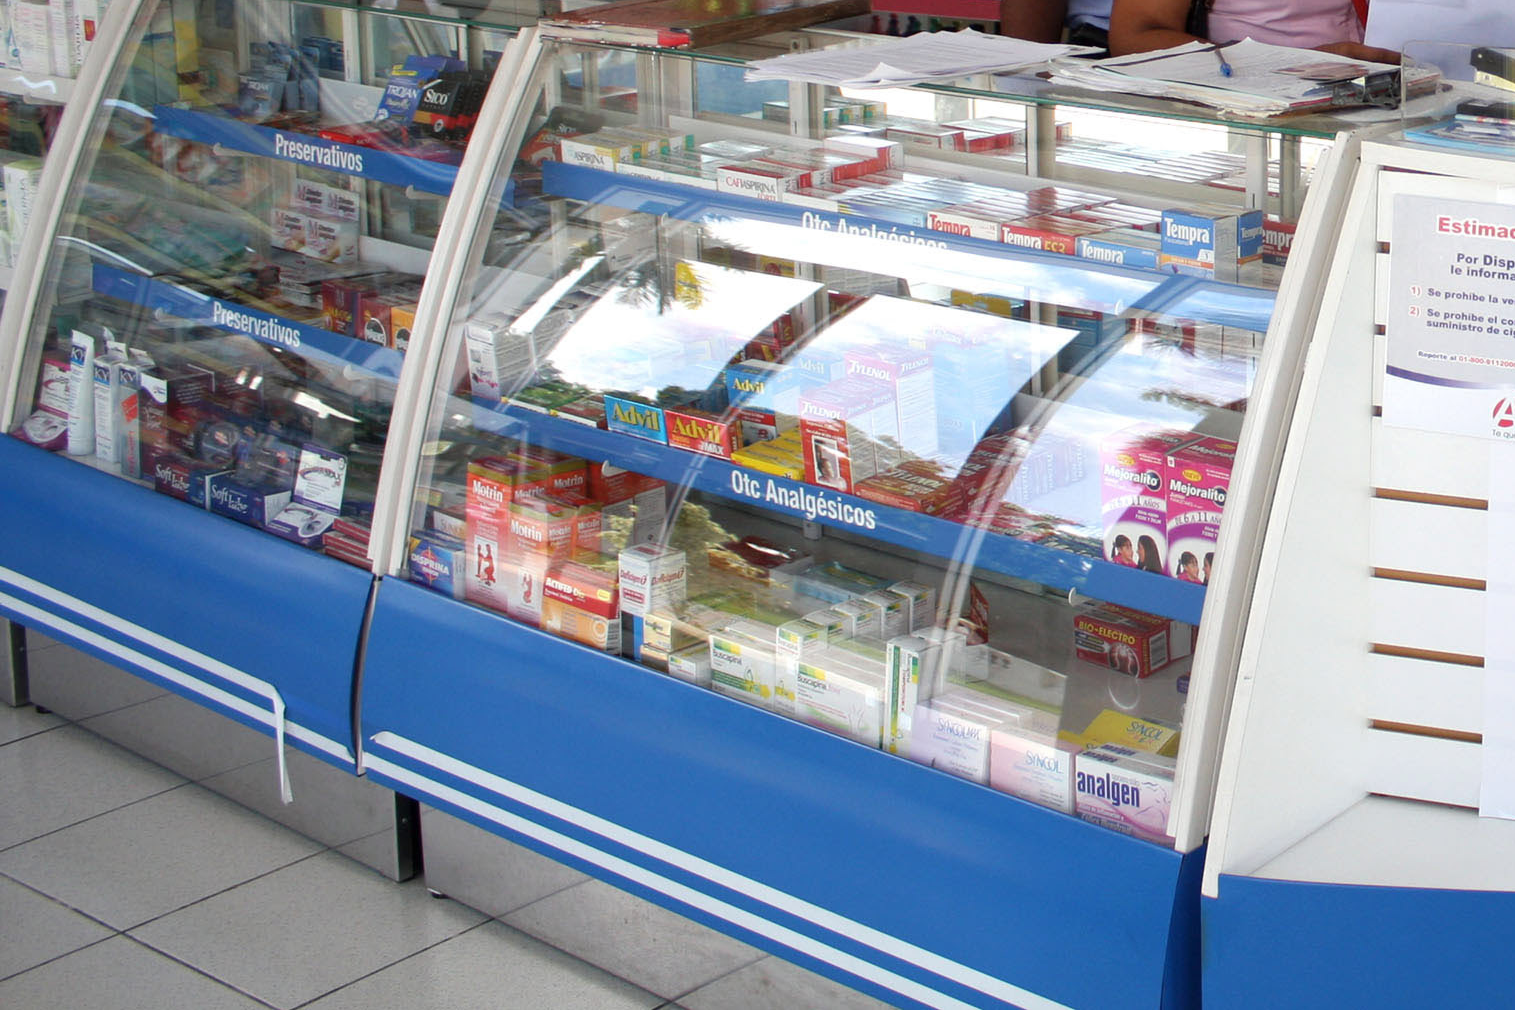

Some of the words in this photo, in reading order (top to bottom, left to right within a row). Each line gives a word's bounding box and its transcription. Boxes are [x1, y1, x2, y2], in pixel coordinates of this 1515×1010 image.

[387, 84, 418, 99] TROJAN
[275, 133, 363, 172] Preservativos
[574, 151, 605, 166] ASPIRINA
[1002, 226, 1042, 251] Tempra
[1164, 216, 1211, 244] Tempra
[1081, 239, 1125, 265] Tempra
[1456, 253, 1479, 265] Por
[1450, 265, 1463, 275] le
[1411, 286, 1422, 297] 1)
[1427, 287, 1441, 298] Se
[1444, 289, 1486, 305] prohibe
[1488, 295, 1499, 305] la
[212, 301, 301, 349] Preservativos
[1409, 306, 1420, 317] 2)
[1427, 308, 1440, 319] Se
[1443, 310, 1485, 325] prohibe
[1488, 315, 1498, 325] el
[1426, 320, 1483, 335] suministro
[1486, 326, 1500, 336] de
[849, 360, 892, 382] TYLENOL
[732, 377, 766, 394] Advil
[611, 402, 660, 432] Advil
[802, 401, 842, 421] TYLENOL
[672, 415, 721, 445] Advil
[553, 474, 584, 489] Motrin
[1104, 464, 1158, 487] Mejoralito
[473, 480, 503, 502] Motrin
[732, 470, 764, 501] Otc
[767, 479, 877, 530] Analgésicos
[1169, 479, 1226, 502] Mejoralito
[510, 520, 542, 542] Motrin
[1078, 620, 1136, 645] BIO-ELECTRO
[1026, 750, 1064, 774] SYNCOL
[1076, 770, 1141, 808] analgen
